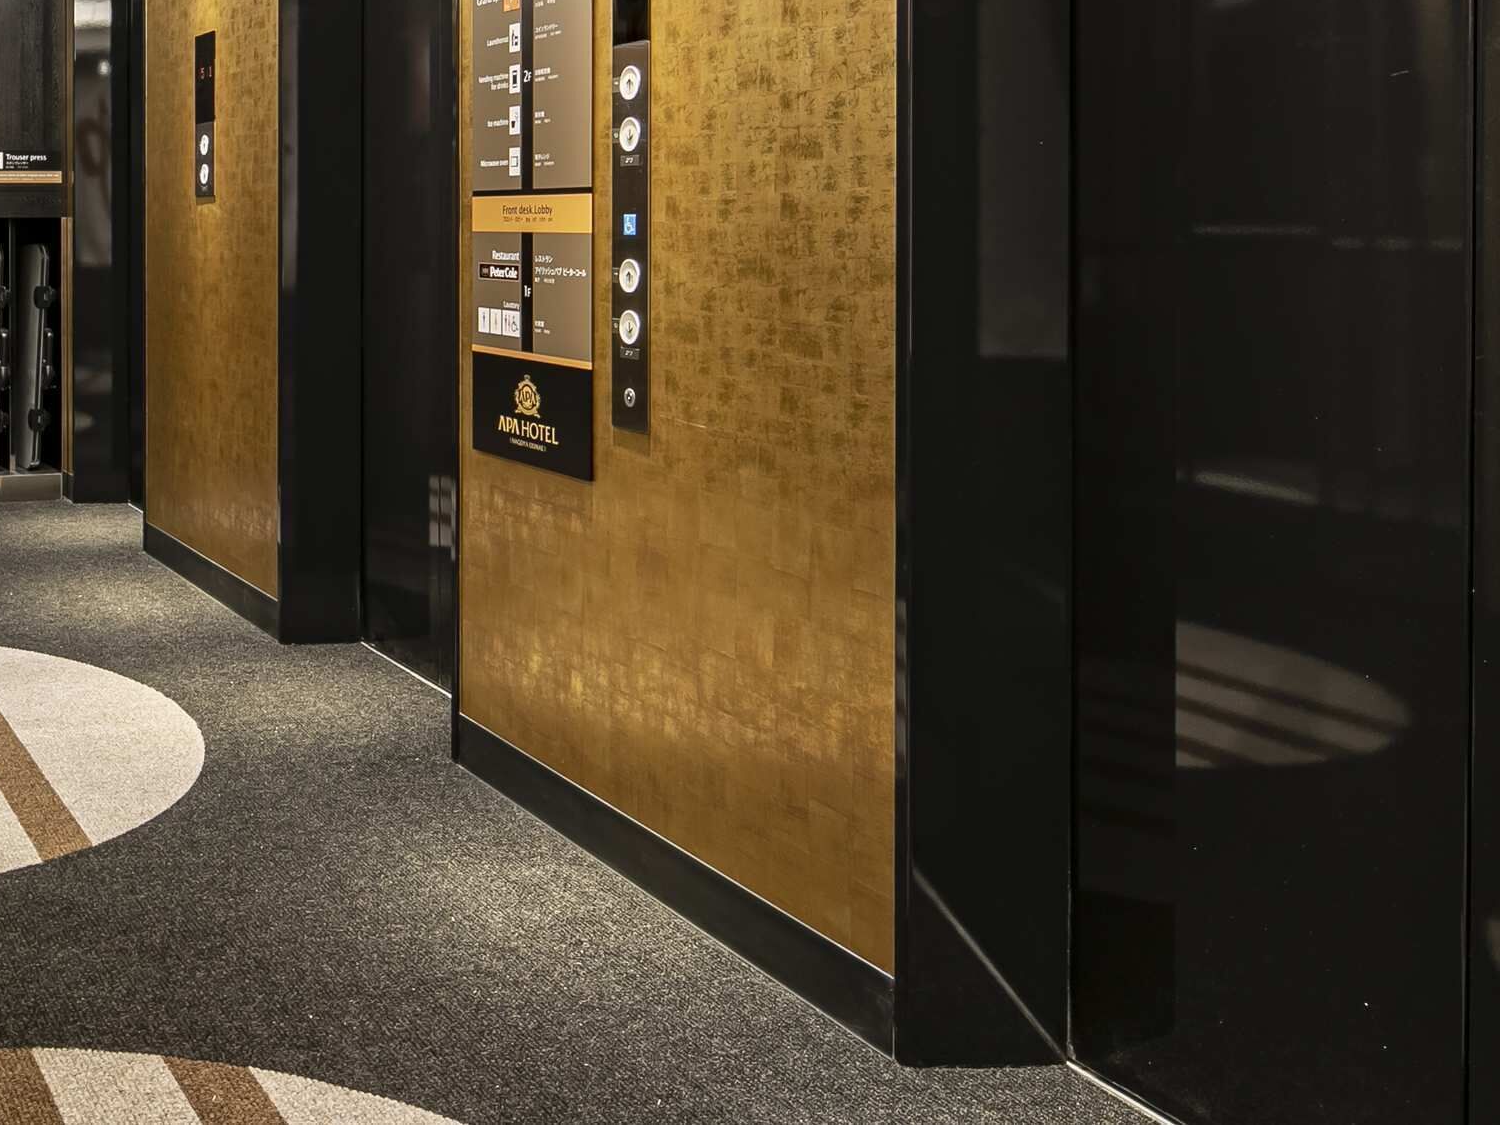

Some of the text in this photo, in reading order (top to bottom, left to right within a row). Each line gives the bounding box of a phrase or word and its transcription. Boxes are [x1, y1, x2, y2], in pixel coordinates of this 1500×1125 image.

[5, 153, 47, 162] Trouser press
[502, 204, 518, 215] Front
[491, 250, 520, 261] Restaurant
[498, 415, 559, 445] APA HOTEL
